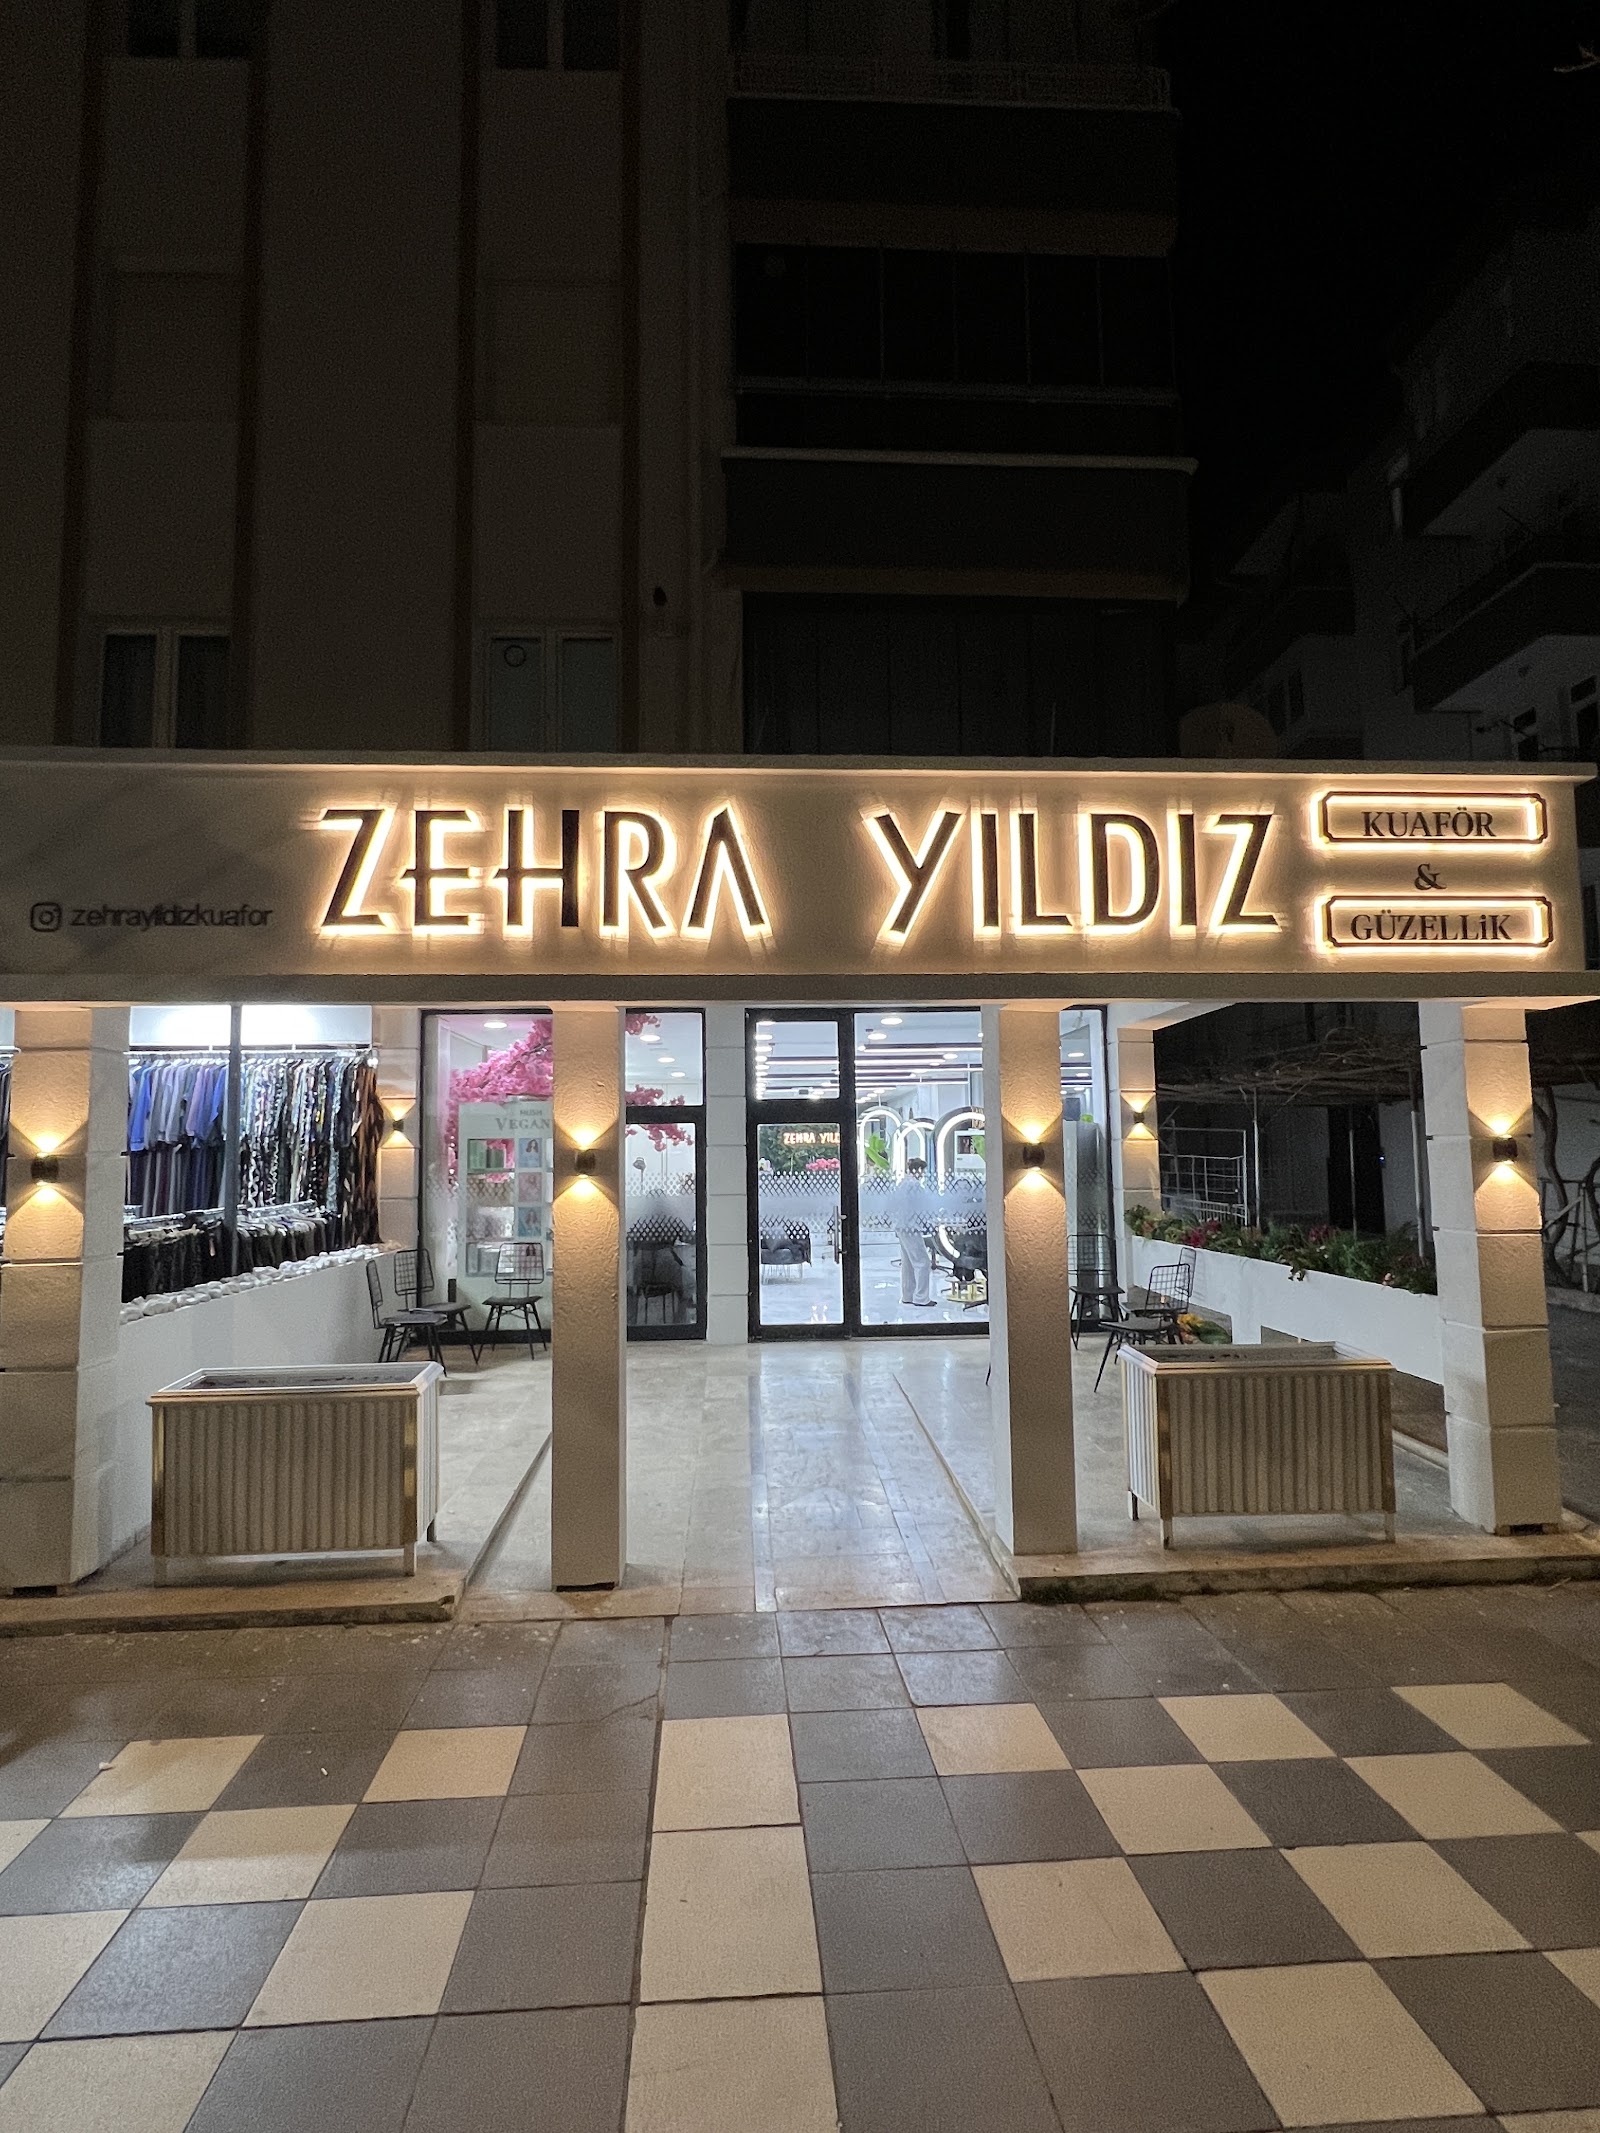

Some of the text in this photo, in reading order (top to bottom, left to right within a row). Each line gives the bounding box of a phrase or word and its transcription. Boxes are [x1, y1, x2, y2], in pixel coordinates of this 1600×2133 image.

[1361, 806, 1496, 838] KUAFÖR
[320, 807, 1281, 932] ZEHRA YILDIZ
[1414, 863, 1447, 891] &
